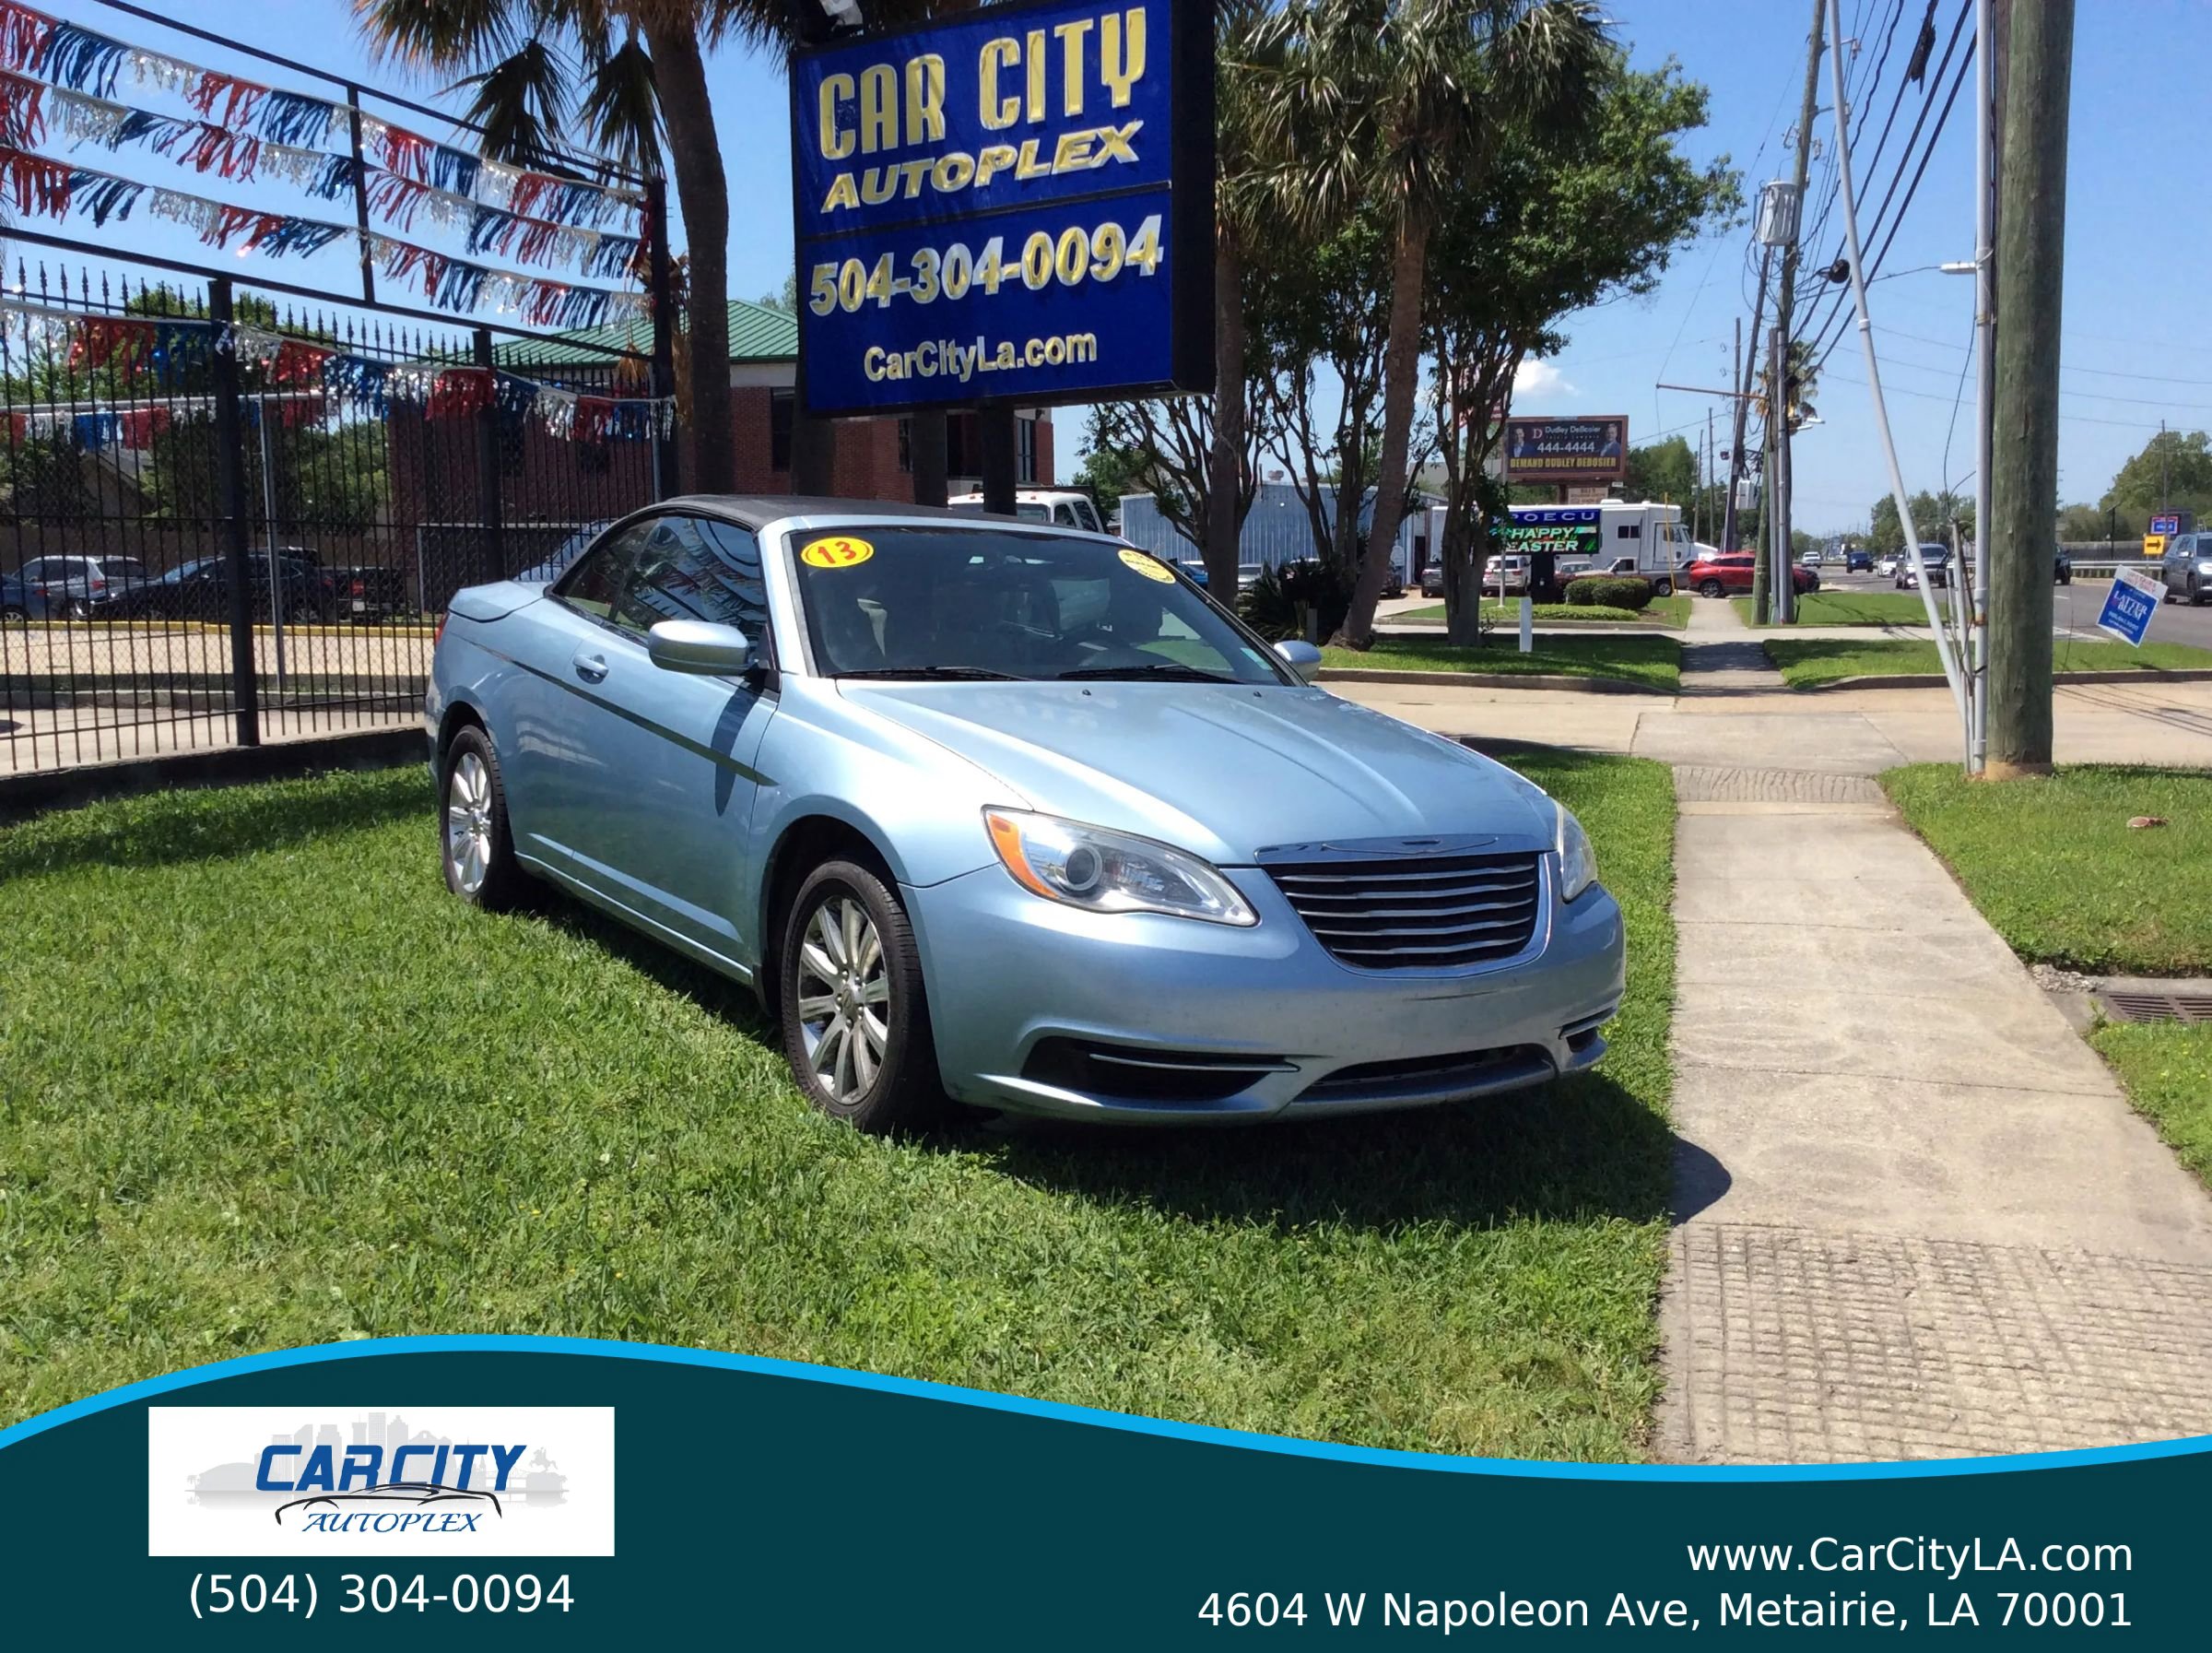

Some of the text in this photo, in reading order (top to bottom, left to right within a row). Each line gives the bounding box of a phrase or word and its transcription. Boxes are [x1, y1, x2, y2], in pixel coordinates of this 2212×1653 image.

[819, 6, 1147, 160] CAR CITY
[820, 120, 1145, 214] AUTOPLEX
[808, 214, 1164, 316] 504-304-0094
[864, 331, 1098, 383] CarCityLa.com
[1510, 457, 1544, 468] DEMAND
[1536, 442, 1595, 453] 444-4444
[1511, 526, 1574, 539] HAPPY
[818, 540, 857, 564] 13
